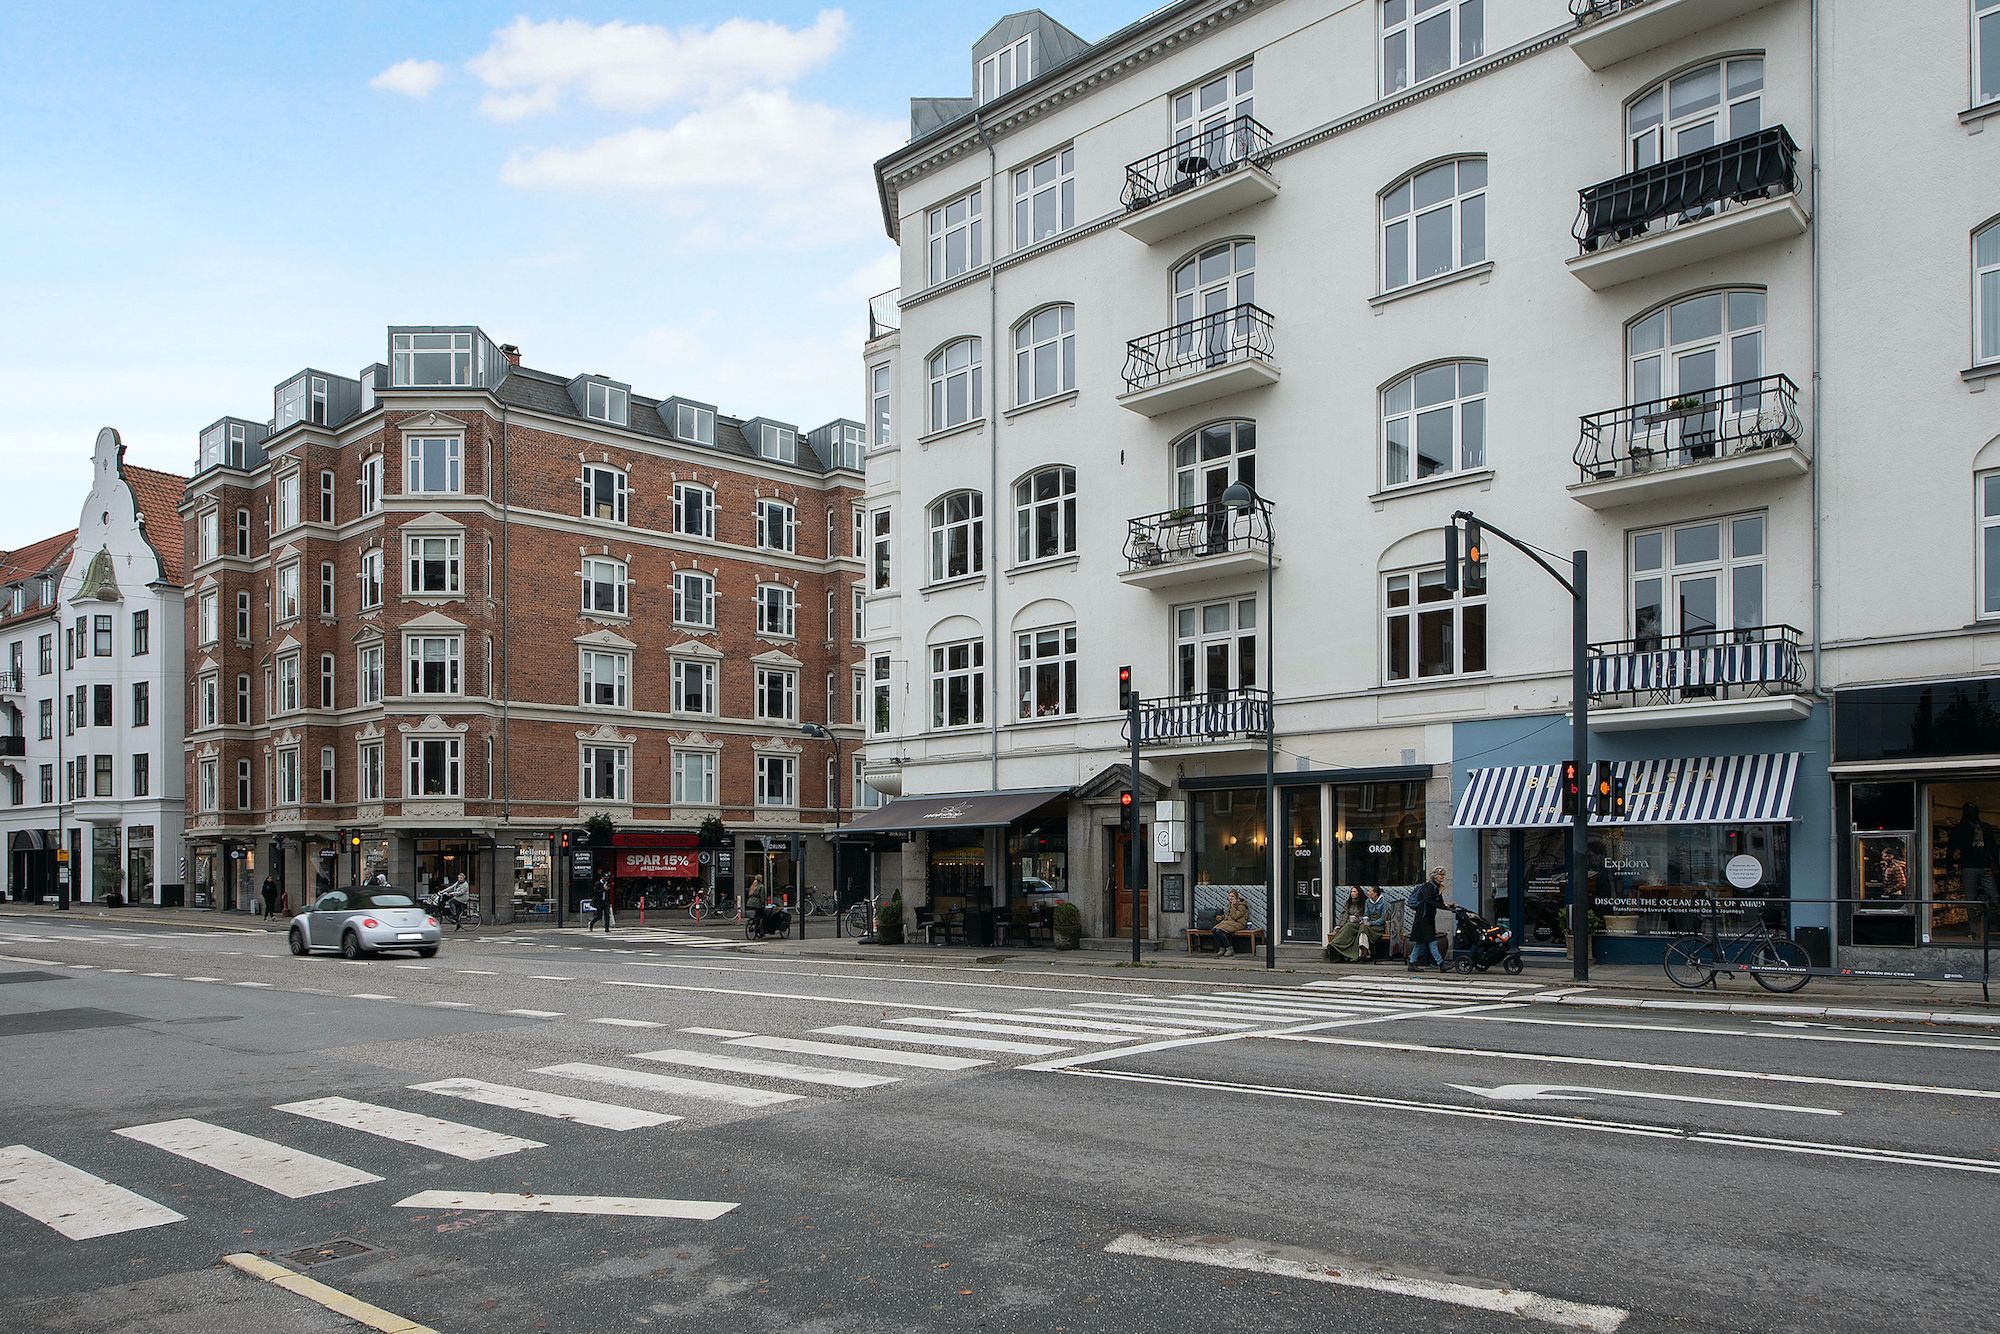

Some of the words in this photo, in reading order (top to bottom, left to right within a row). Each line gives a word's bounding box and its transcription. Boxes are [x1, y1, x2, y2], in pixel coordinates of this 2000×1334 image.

[1631, 769, 1716, 785] VISTA
[626, 854, 661, 866] SPAR
[663, 854, 690, 867] 15%
[1604, 857, 1649, 872] Explora
[1594, 897, 1638, 906] DISCOVER
[1639, 898, 1658, 906] THE
[1659, 898, 1692, 907] OCEAN
[1694, 898, 1721, 907] STAE
[1612, 906, 1648, 914] Transforming
[1648, 906, 1667, 914] Luxury
